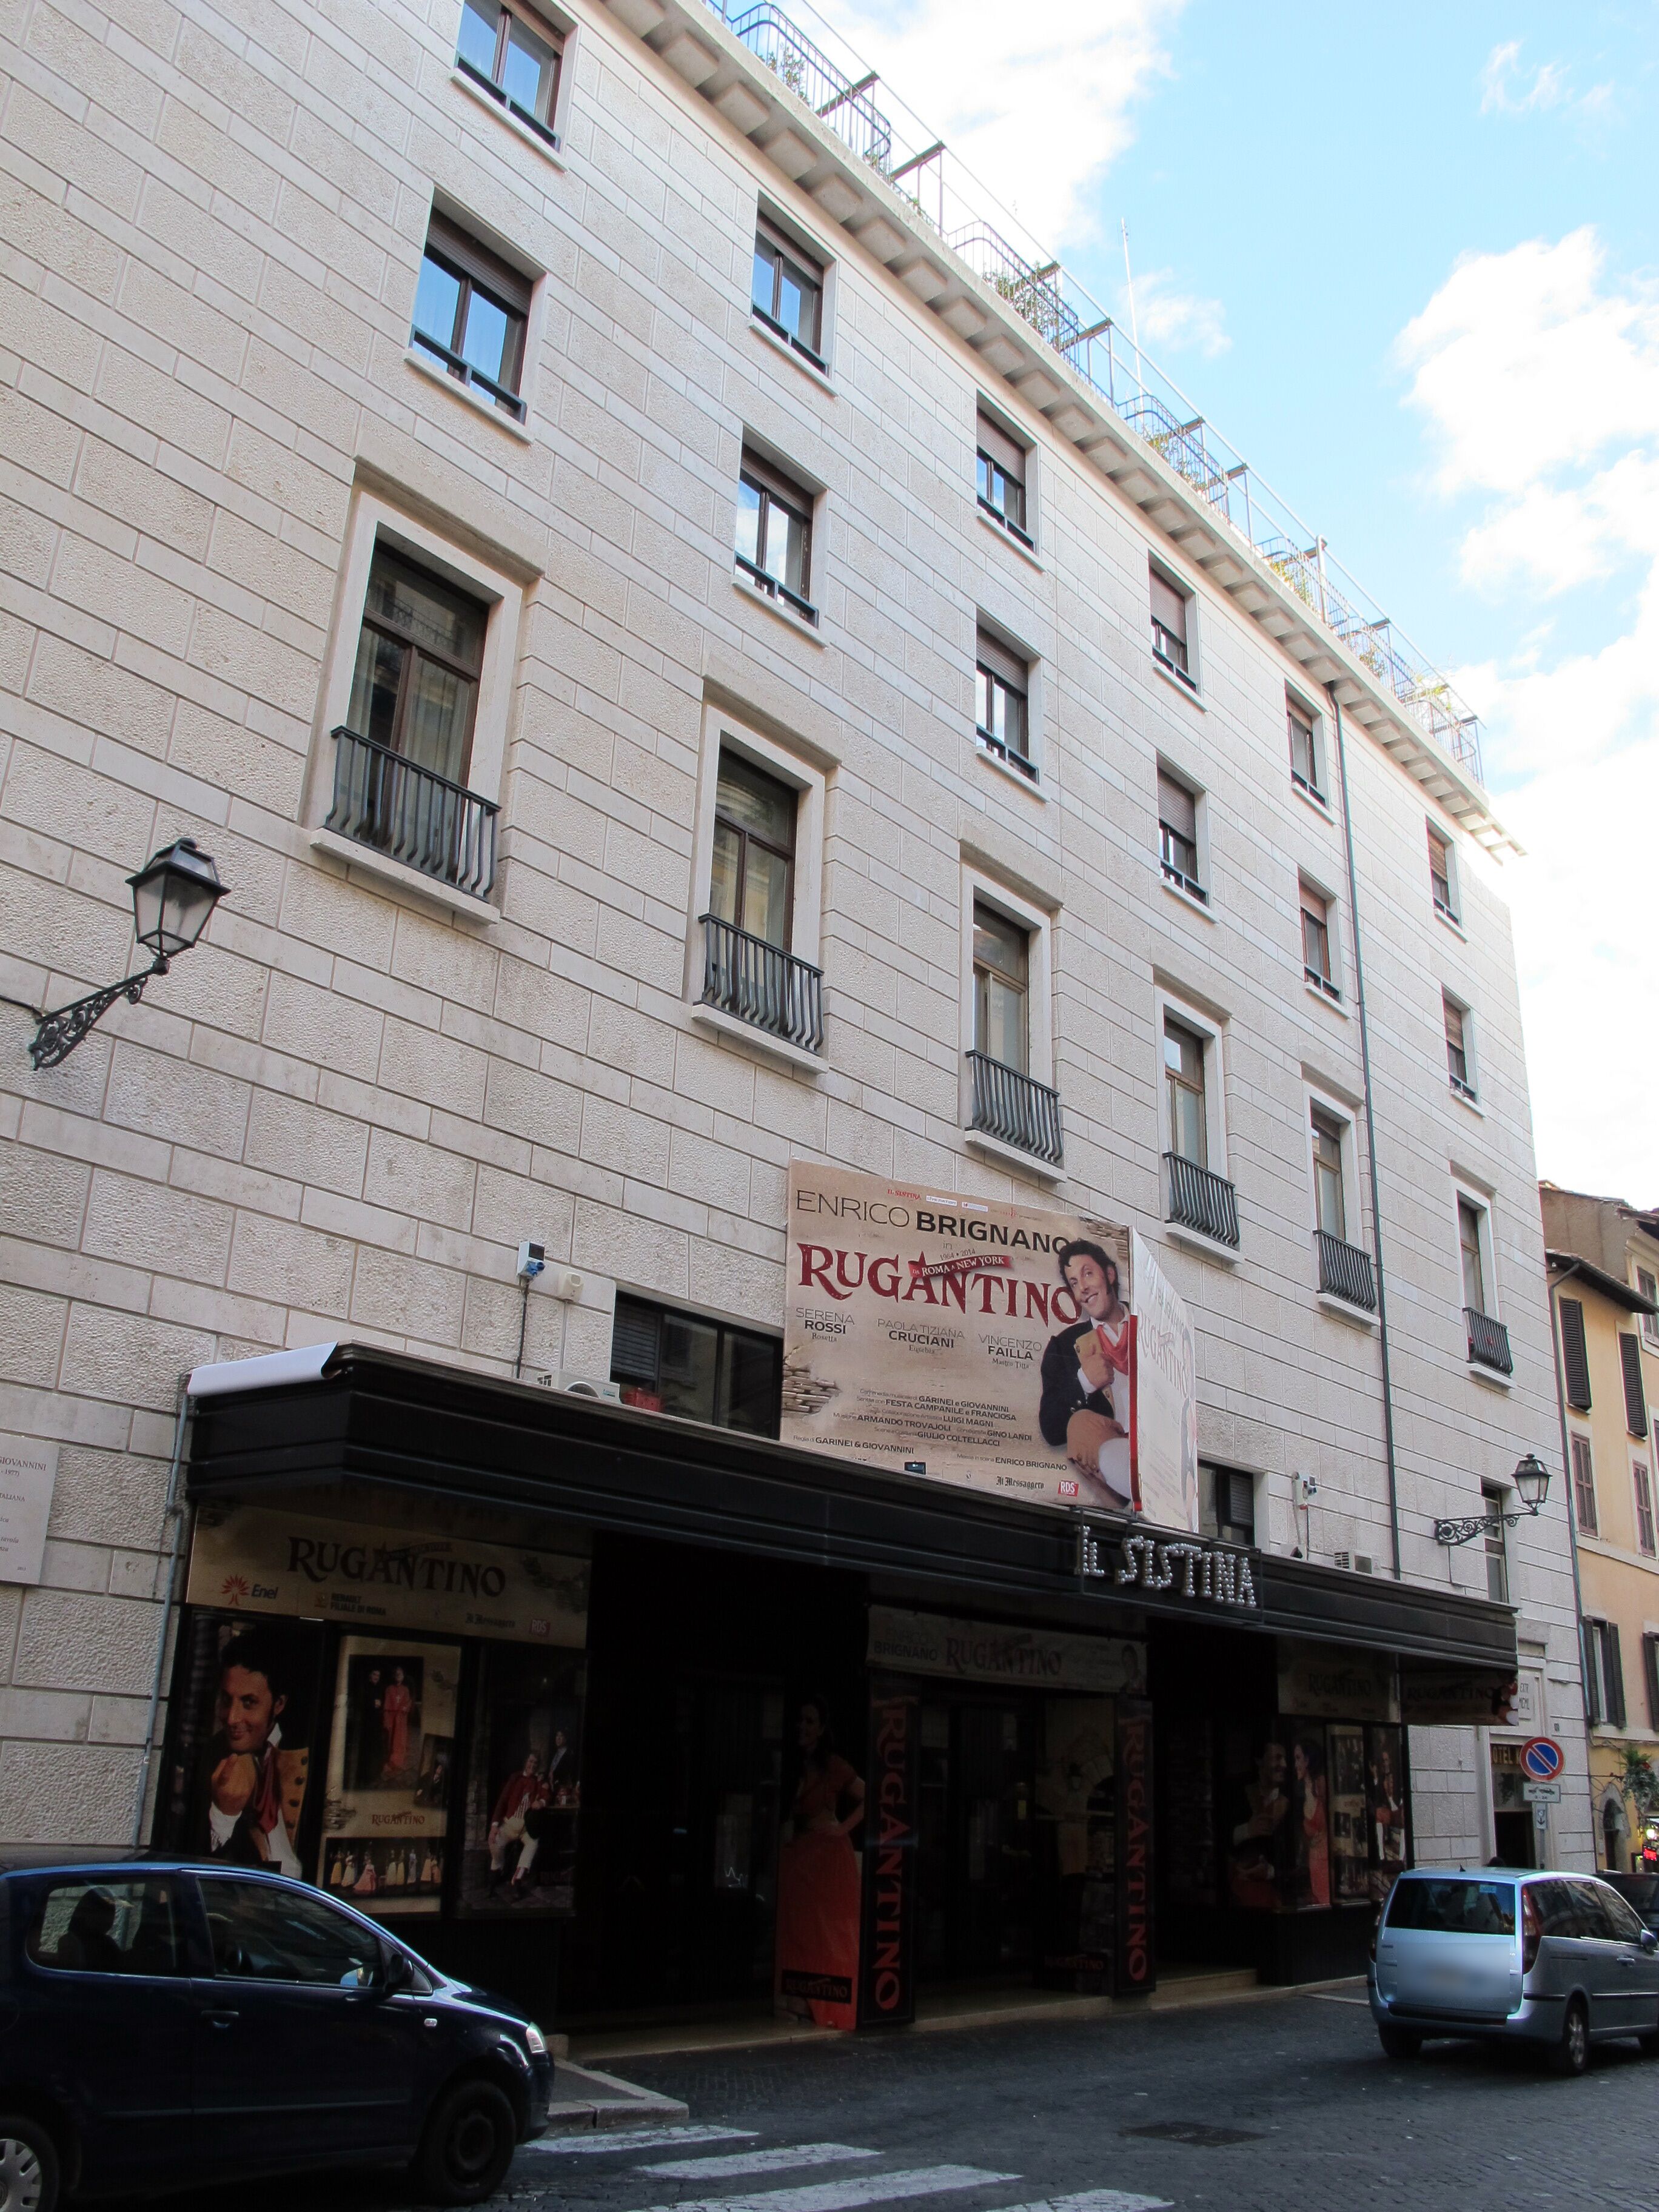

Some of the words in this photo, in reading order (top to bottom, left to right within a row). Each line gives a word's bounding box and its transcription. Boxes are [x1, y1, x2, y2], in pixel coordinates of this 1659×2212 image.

[796, 1190, 910, 1227] ENRICO
[916, 1210, 1070, 1255] BRIGNANO
[943, 1240, 953, 1250] in
[940, 1252, 954, 1261] 1964
[961, 1248, 976, 1257] 2014
[922, 1265, 950, 1276] ROMA
[957, 1259, 977, 1270] NEW
[979, 1256, 1005, 1267] YORK
[797, 1242, 1082, 1327] RUGANTINO
[796, 1307, 855, 1326] SERENA
[805, 1319, 846, 1335] ROSSI
[877, 1318, 918, 1333] PAOLA
[920, 1324, 965, 1339] TIZIANA
[812, 1332, 837, 1343] Rosetta
[888, 1330, 954, 1349] CRUCIANI
[978, 1333, 1042, 1352] VINCENZO
[988, 1346, 1034, 1361] FAILLA
[992, 1358, 1013, 1368] Mastro
[1015, 1361, 1030, 1370] Titta
[886, 1399, 913, 1409] FESTA
[914, 1403, 964, 1415] CAMPANILE
[971, 1409, 1017, 1421] FRANCIOSA
[919, 1395, 954, 1406] GARINEI
[960, 1401, 1009, 1413] GIOVANNINI
[857, 1414, 903, 1426] ARMANDO
[904, 1420, 951, 1432] TROVAJOLI
[943, 1415, 964, 1424] LUIGI
[966, 1418, 993, 1427] MAGNI
[917, 1431, 945, 1440] GIULIO
[947, 1434, 1000, 1447] COLTELLACCI
[987, 1430, 1007, 1439] GINO
[1008, 1432, 1032, 1441] LANDI
[815, 1436, 853, 1447] GARINEI
[862, 1442, 914, 1455] GIOVANNINI
[995, 1456, 1025, 1466] ENRICO
[1026, 1460, 1067, 1471] BRIGNANO
[1004, 1477, 1044, 1490] Messaggero
[1061, 1481, 1076, 1495] RDS
[287, 1536, 506, 1599] RUGANTINO
[1074, 1525, 1105, 1577] IL
[1114, 1534, 1257, 1608] SISTINA
[252, 1584, 279, 1600] Enel
[532, 1618, 548, 1634] RDS
[874, 1640, 937, 1661] BRIGNANO
[945, 1637, 1062, 1675] RUGANTINO
[372, 1812, 425, 1826] RUGANTINO
[872, 1706, 910, 2010] RUGANTINO
[1123, 1724, 1150, 1982] RUGANTINO
